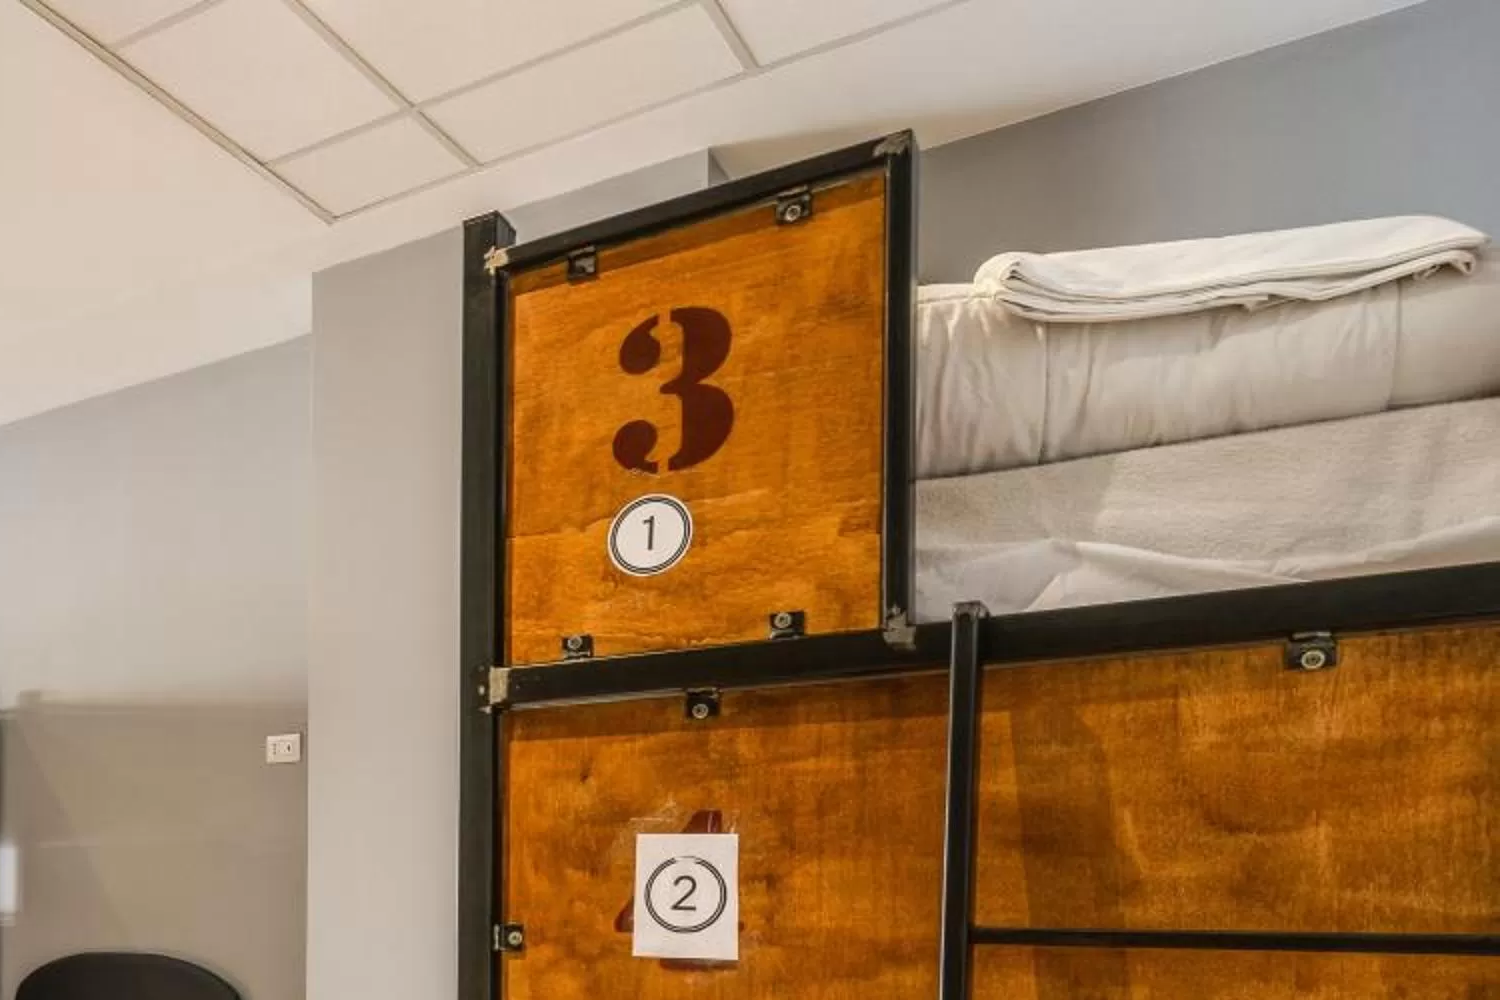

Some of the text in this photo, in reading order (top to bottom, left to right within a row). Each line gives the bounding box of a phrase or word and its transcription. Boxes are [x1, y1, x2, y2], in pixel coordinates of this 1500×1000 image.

[612, 306, 735, 474] 3
[643, 515, 655, 551] 1
[671, 875, 697, 911] 2
